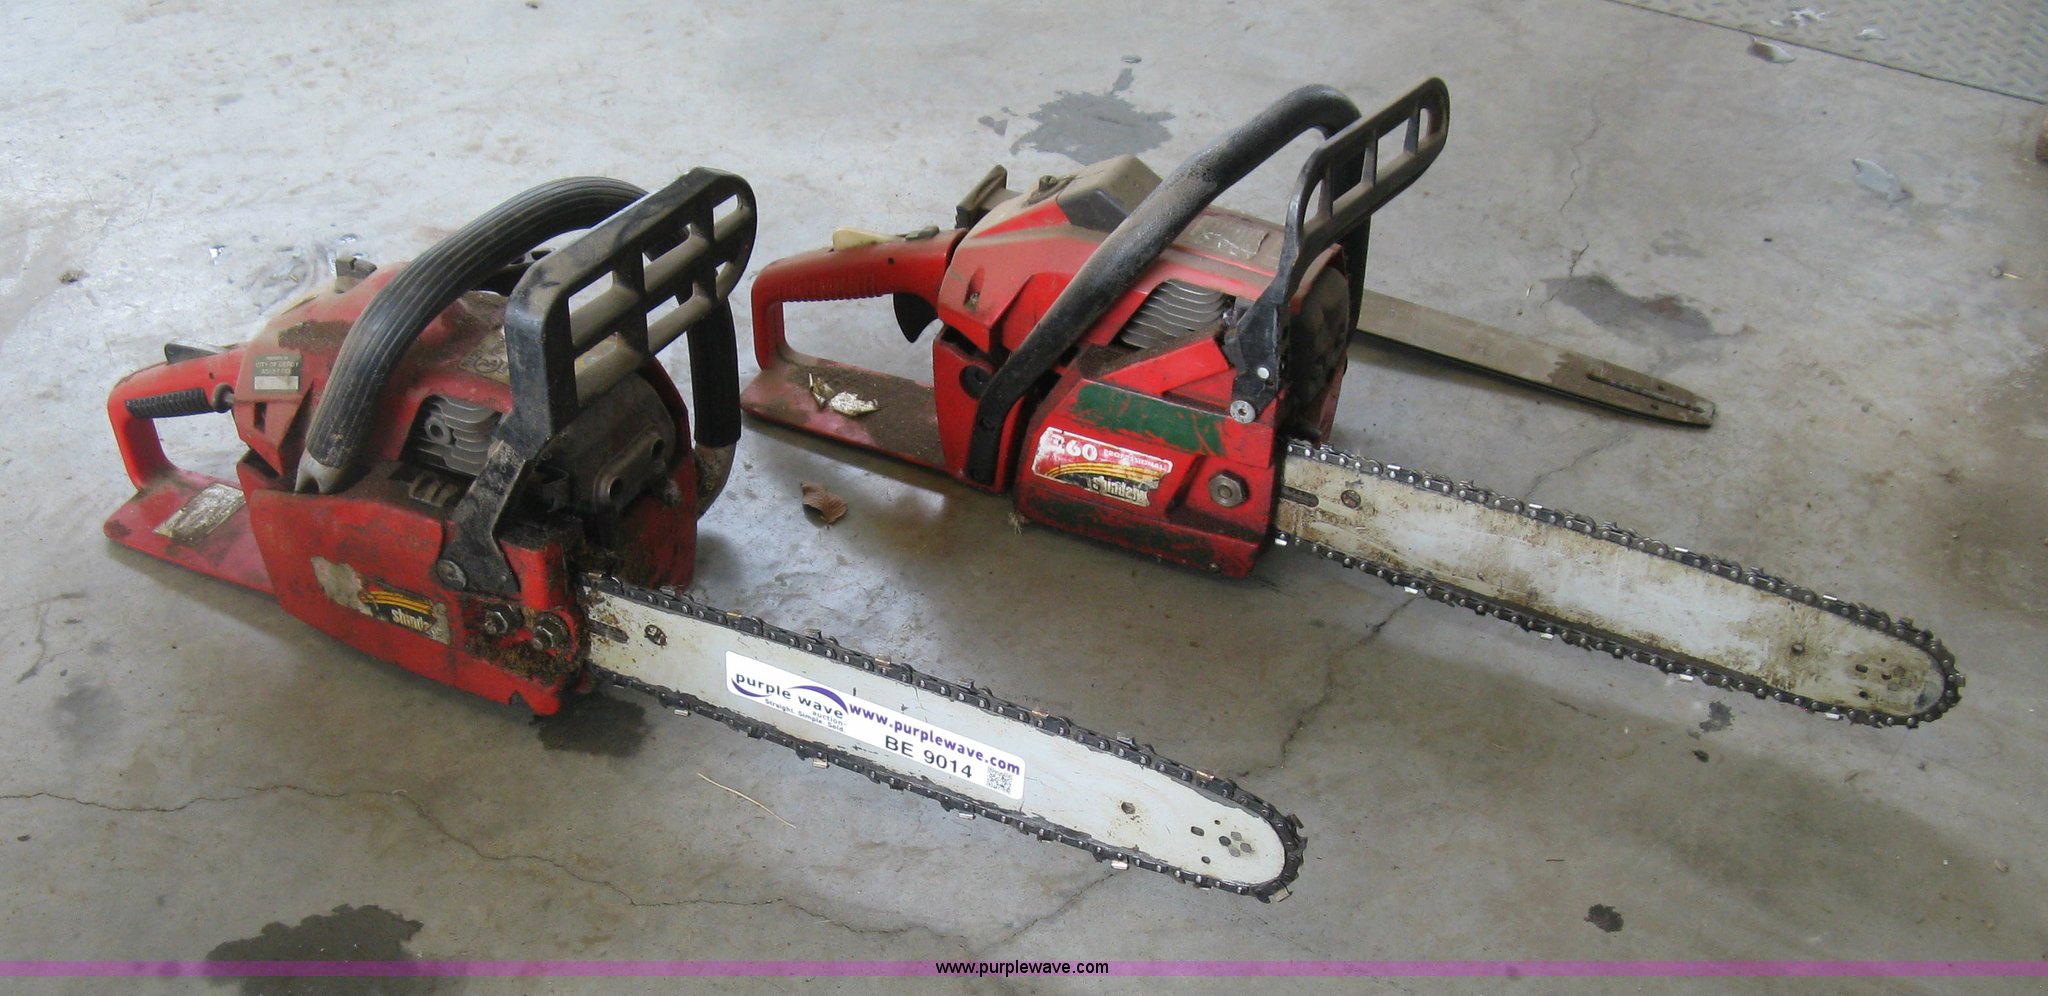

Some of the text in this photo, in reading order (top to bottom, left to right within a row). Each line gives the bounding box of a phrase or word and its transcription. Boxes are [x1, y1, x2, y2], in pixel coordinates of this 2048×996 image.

[735, 672, 843, 719] purple wave
[765, 698, 796, 714] Straight.
[798, 710, 826, 724] Simple.
[849, 703, 1020, 776] www.purplewave.com
[885, 735, 973, 779] BE 9014
